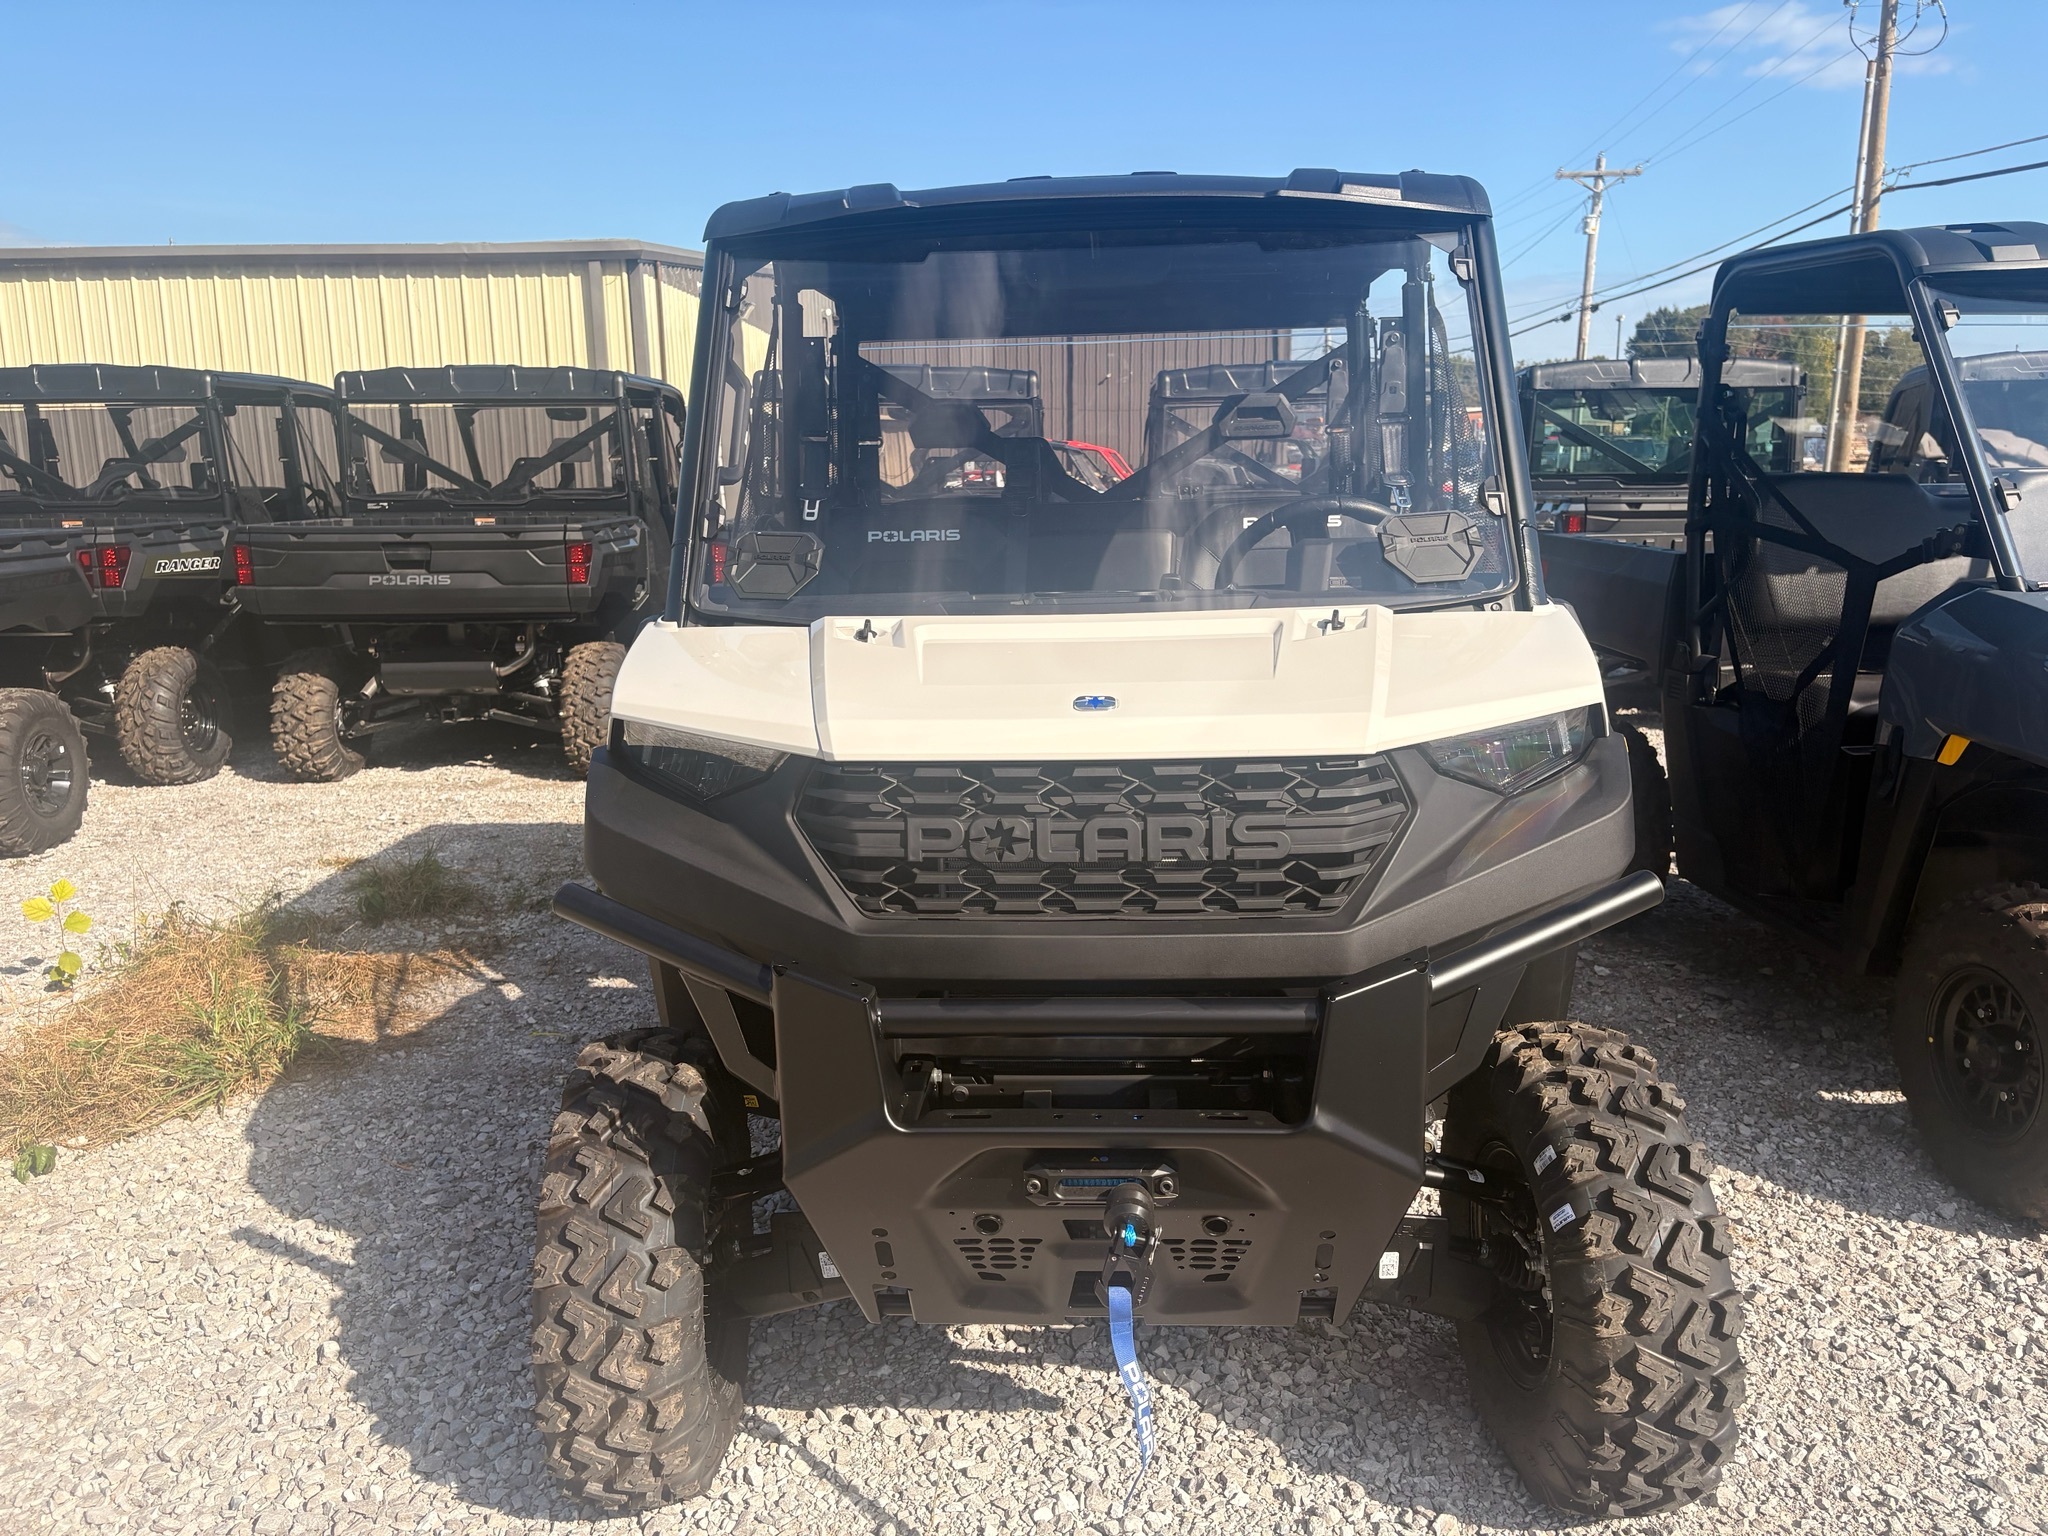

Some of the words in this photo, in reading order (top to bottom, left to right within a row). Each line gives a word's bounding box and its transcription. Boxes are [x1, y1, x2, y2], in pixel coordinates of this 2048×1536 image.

[868, 529, 961, 542] POLARIS
[155, 556, 221, 574] RANGER
[369, 574, 451, 586] POLARIS
[906, 811, 1291, 863] POLARIS
